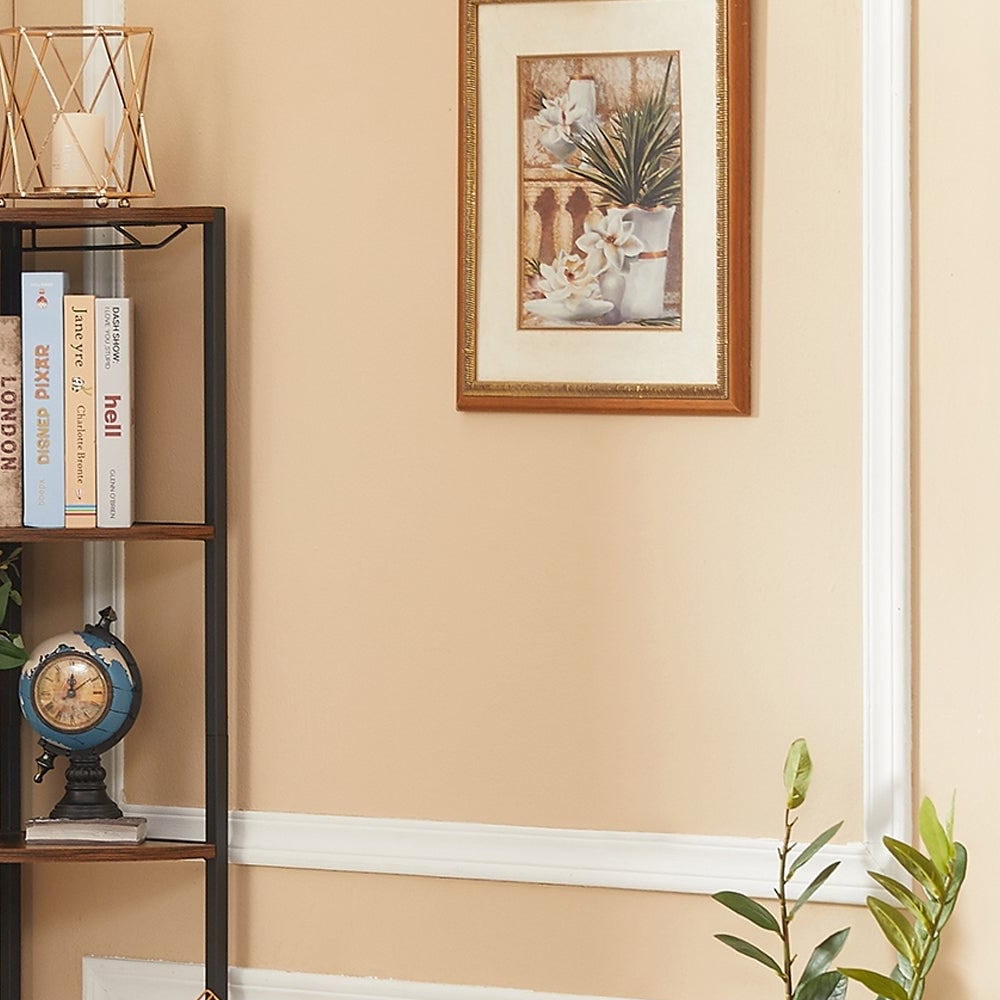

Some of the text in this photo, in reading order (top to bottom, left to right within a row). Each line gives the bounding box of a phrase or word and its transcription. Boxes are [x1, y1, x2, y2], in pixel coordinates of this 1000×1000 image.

[71, 306, 87, 368] Jane yre
[112, 306, 120, 332] DASH
[34, 344, 50, 400] PIXAR
[1, 376, 18, 472] LONDON
[75, 405, 86, 484] Charlotte Bronte
[104, 395, 121, 437] hell
